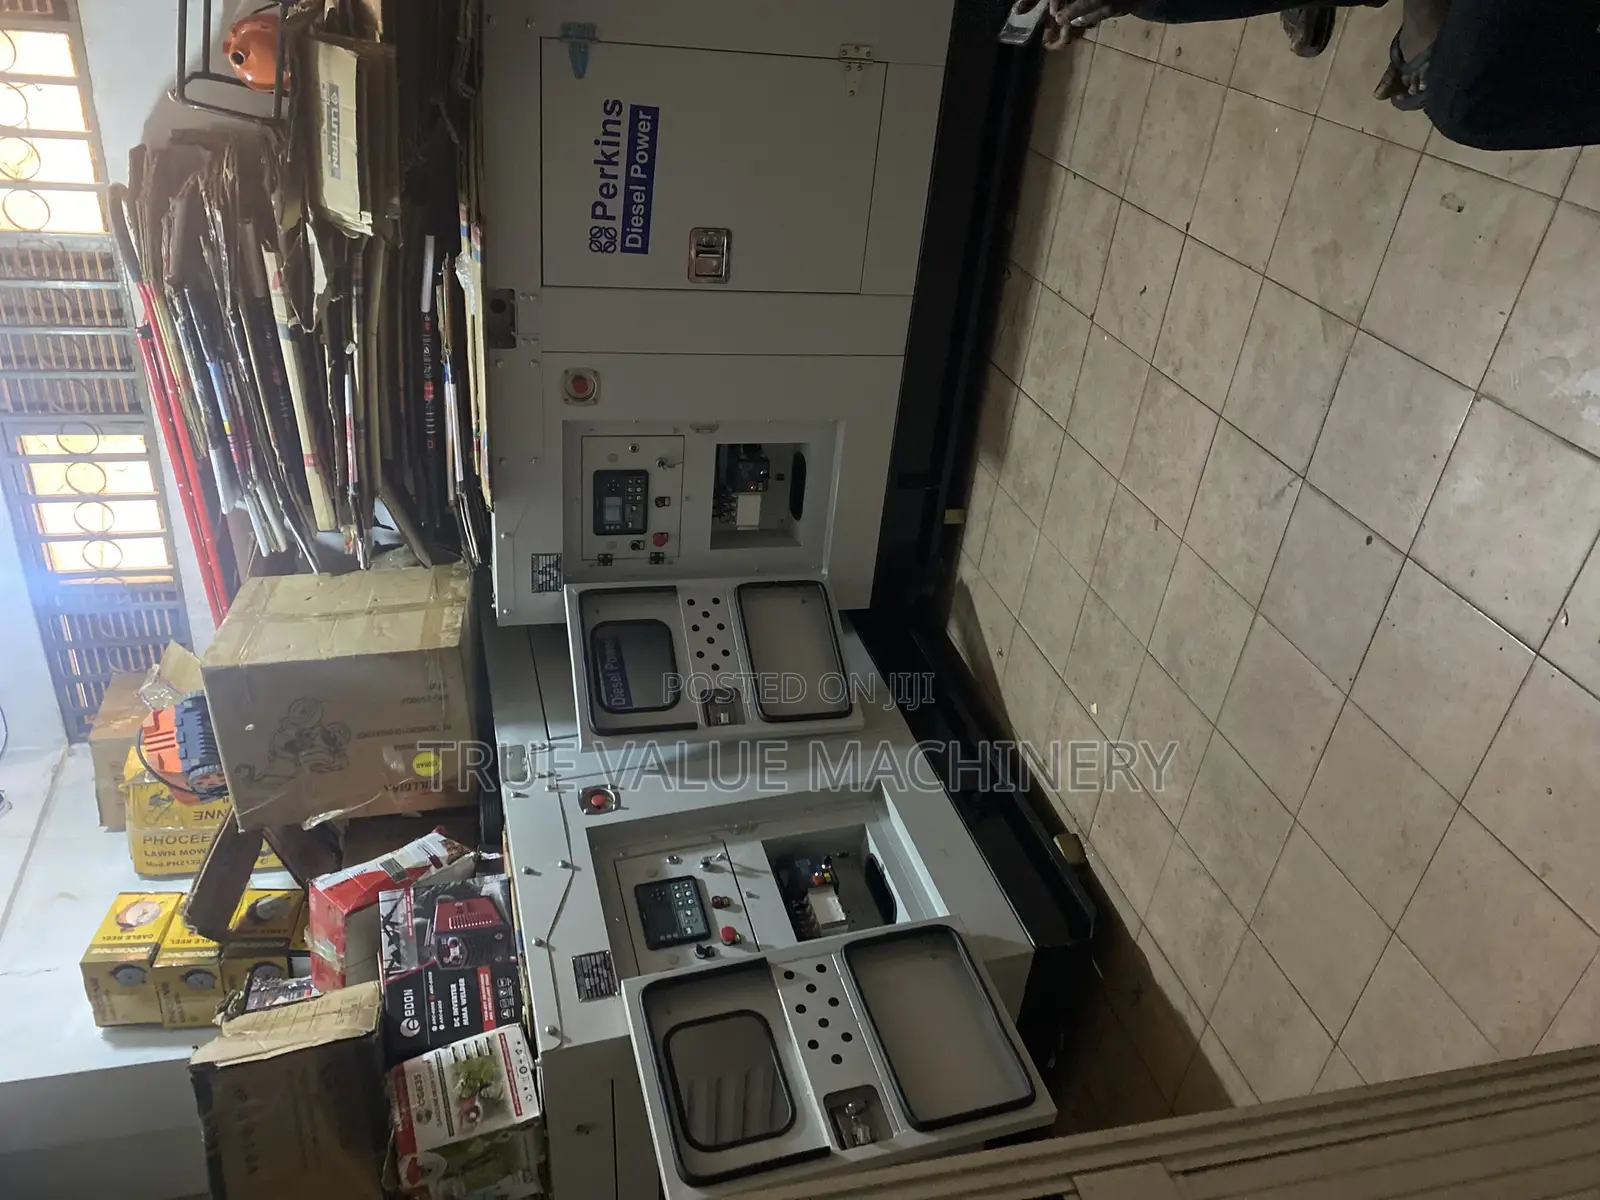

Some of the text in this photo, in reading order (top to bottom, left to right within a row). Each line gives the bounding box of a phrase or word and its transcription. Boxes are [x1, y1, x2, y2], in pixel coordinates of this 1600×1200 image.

[331, 108, 339, 169] LUTIAN
[591, 98, 622, 221] Perkins
[625, 110, 652, 248] Diesel Power
[605, 672, 626, 706] Diesel
[144, 849, 176, 857] LAWN
[124, 933, 154, 942] CABLE
[450, 983, 460, 1027] DC INVERTER
[459, 977, 469, 1026] MMA WELDER
